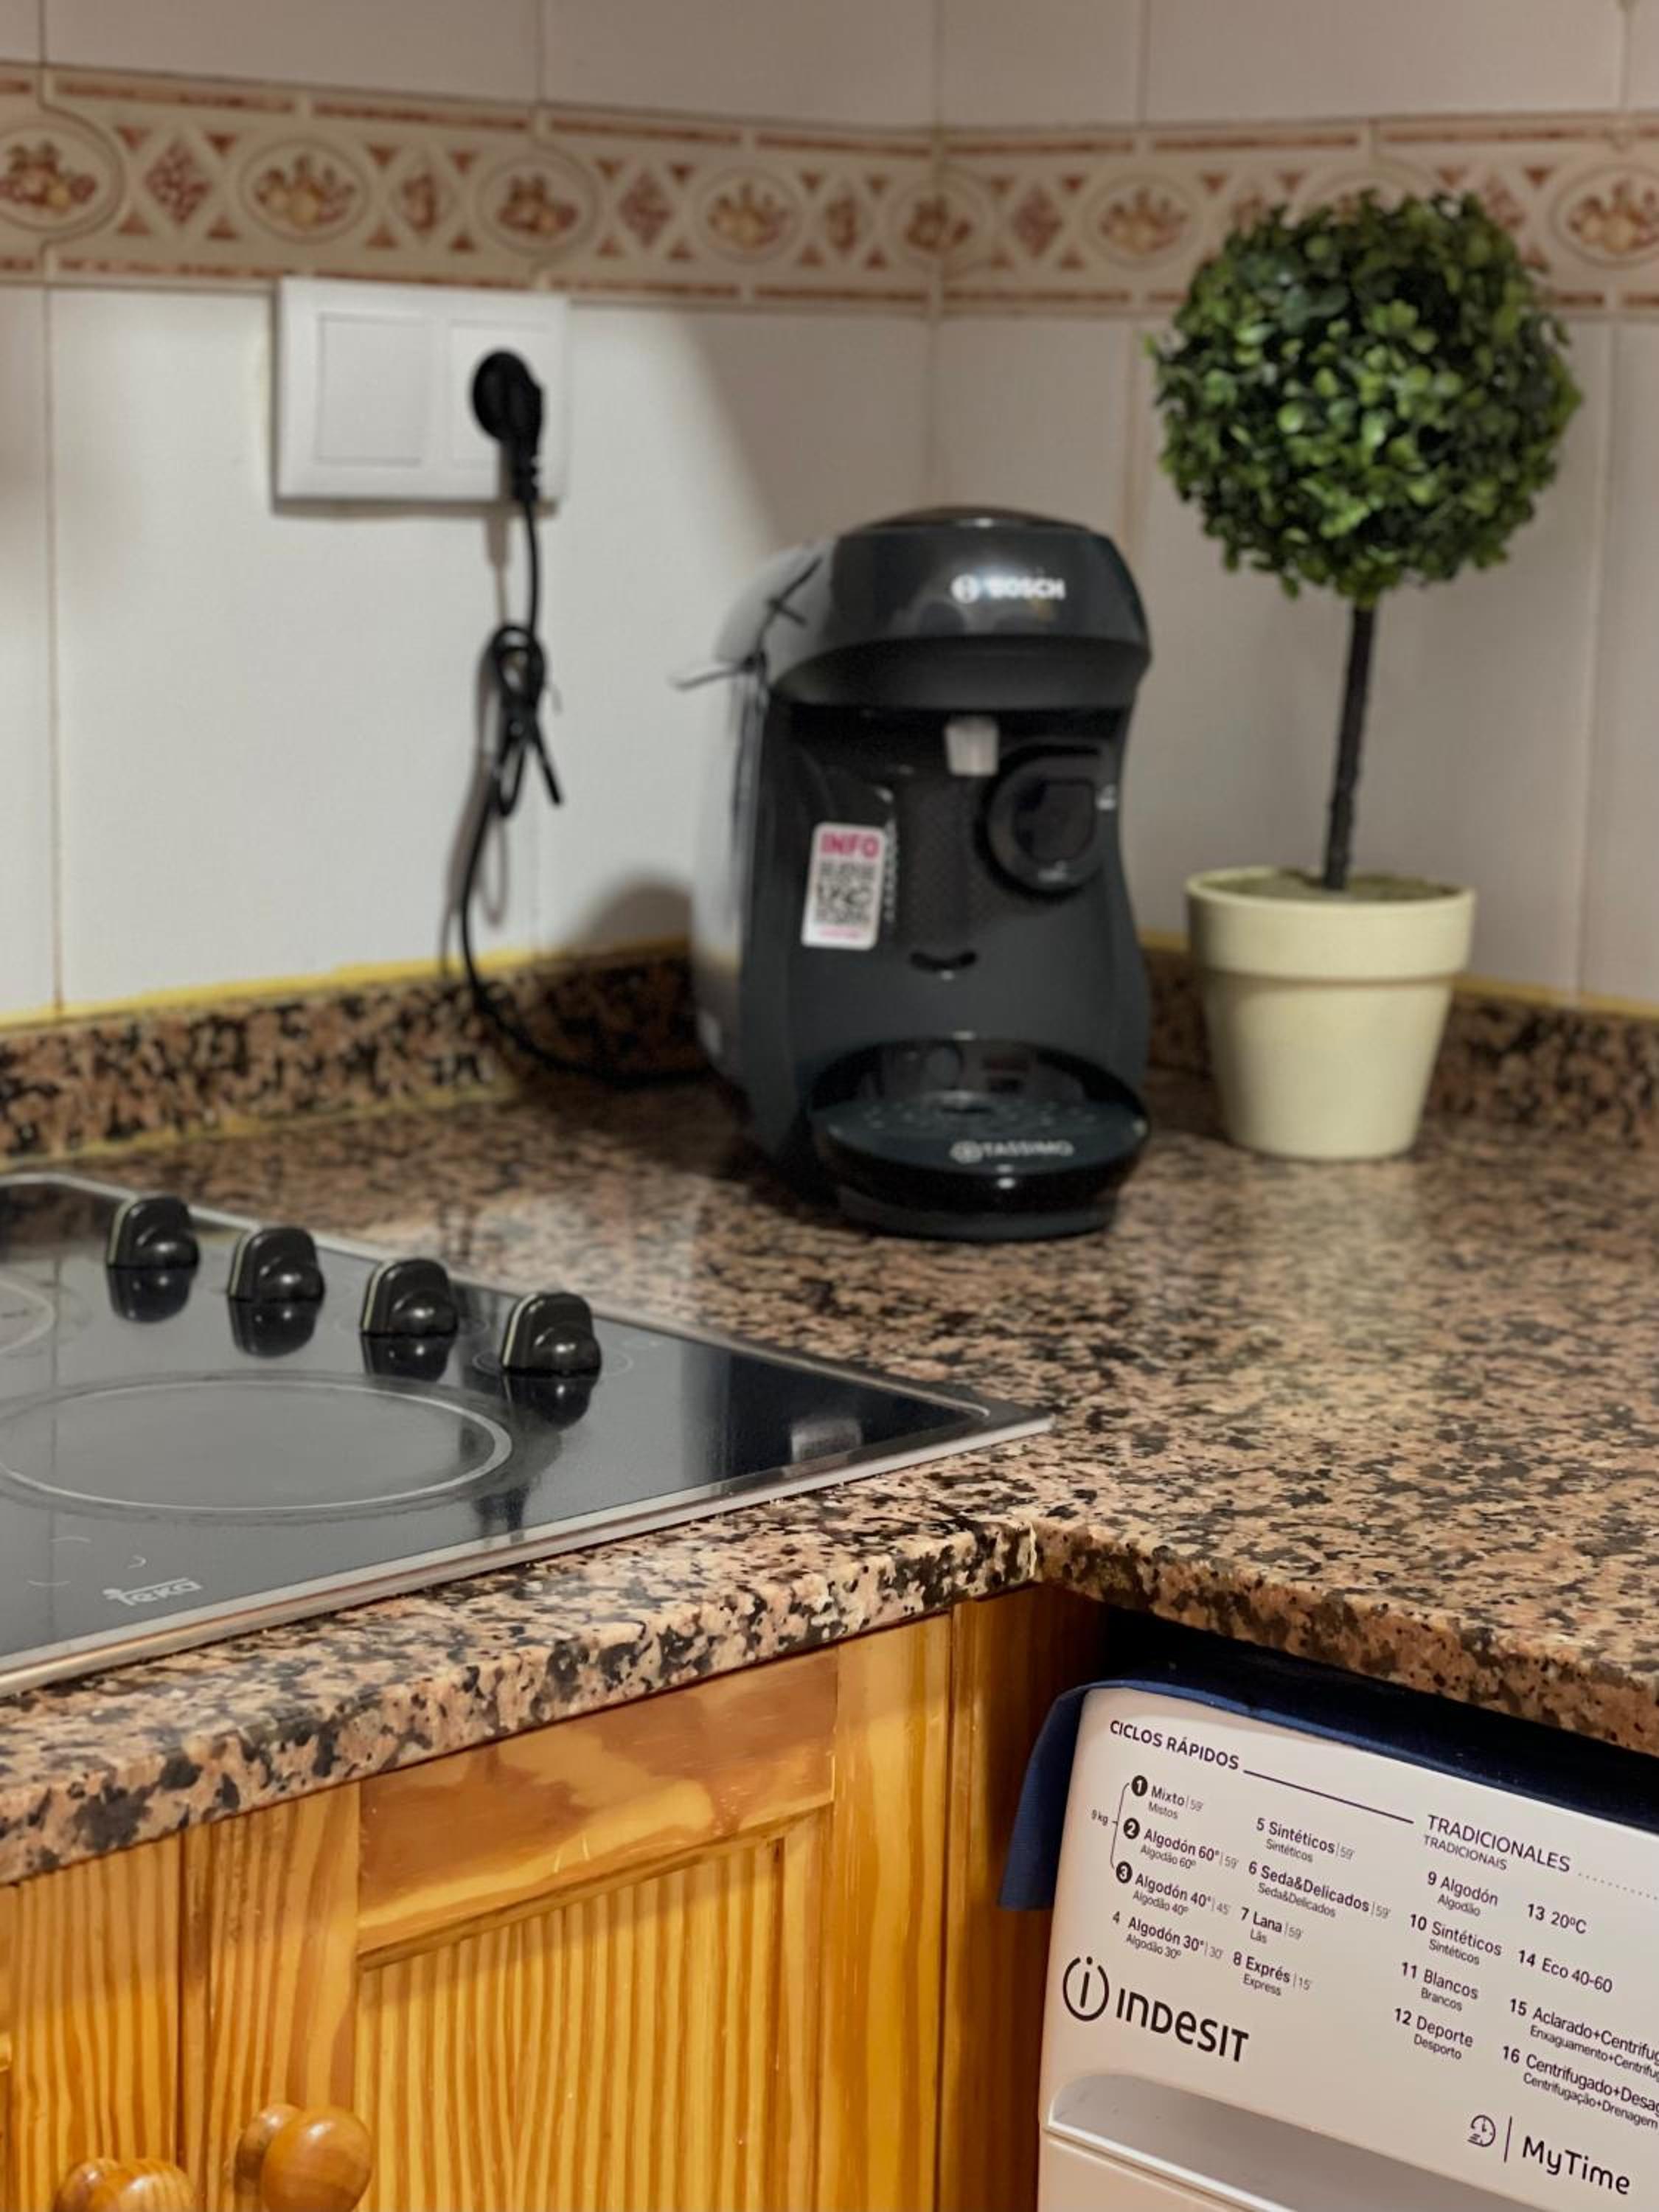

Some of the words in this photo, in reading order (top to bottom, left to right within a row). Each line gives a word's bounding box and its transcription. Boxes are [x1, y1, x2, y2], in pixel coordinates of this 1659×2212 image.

[820, 832, 880, 860] INFO
[1110, 1719, 1163, 1747] CICLOS
[1166, 1737, 1239, 1770] RÁPIDOS
[1151, 1785, 1185, 1807] Mixto
[1098, 1813, 1108, 1826] kg
[1148, 1801, 1178, 1820] Mistos
[1144, 1828, 1196, 1856] Algodón
[1256, 1817, 1265, 1832] 5
[1268, 1820, 1335, 1854] Sintéticos
[1427, 1815, 1571, 1872] TRADICIONALES
[1140, 1844, 1178, 1865] Algodão
[1265, 1838, 1313, 1863] Sintéticos
[1423, 1834, 1508, 1871] TRADICIONAIS
[1132, 1889, 1170, 1911] Algodão
[1135, 1873, 1188, 1902] Algodón
[1248, 1860, 1257, 1876] 6
[1260, 1865, 1369, 1913] Seda&Delicados
[1257, 1882, 1336, 1918] Seda&Delicados
[1427, 1871, 1437, 1885] 9
[1440, 1877, 1499, 1906] Algodón
[1438, 1893, 1481, 1916] Algodão
[1528, 1903, 1545, 1921] 13
[1112, 1910, 1120, 1924] 4
[1127, 1917, 1180, 1946] Algodón
[1240, 1907, 1250, 1922] 7
[1253, 1911, 1283, 1933] Lana
[1126, 1933, 1164, 1955] Algodão
[1410, 1913, 1427, 1931] 10
[1431, 1921, 1503, 1956] Sintéticos
[1429, 1938, 1481, 1965] Sintéticos
[1233, 1951, 1242, 1966] 8
[1245, 1955, 1290, 1983] Exprés
[1402, 1961, 1418, 1979] 11
[1424, 1969, 1479, 2000] Blancos
[1519, 1950, 1536, 1967] 14
[1542, 1958, 1569, 1978] Eco
[1571, 1969, 1613, 1993] 40-60
[1242, 1973, 1282, 1997] Express
[1421, 1987, 1463, 2012] Brancos
[1510, 1998, 1528, 2017] 15
[1394, 2008, 1412, 2025] 12
[1416, 2015, 1473, 2048] Deporte
[1413, 2033, 1462, 2060] Desporto
[1503, 2045, 1521, 2064] 16
[1522, 2135, 1630, 2195] MyTime
